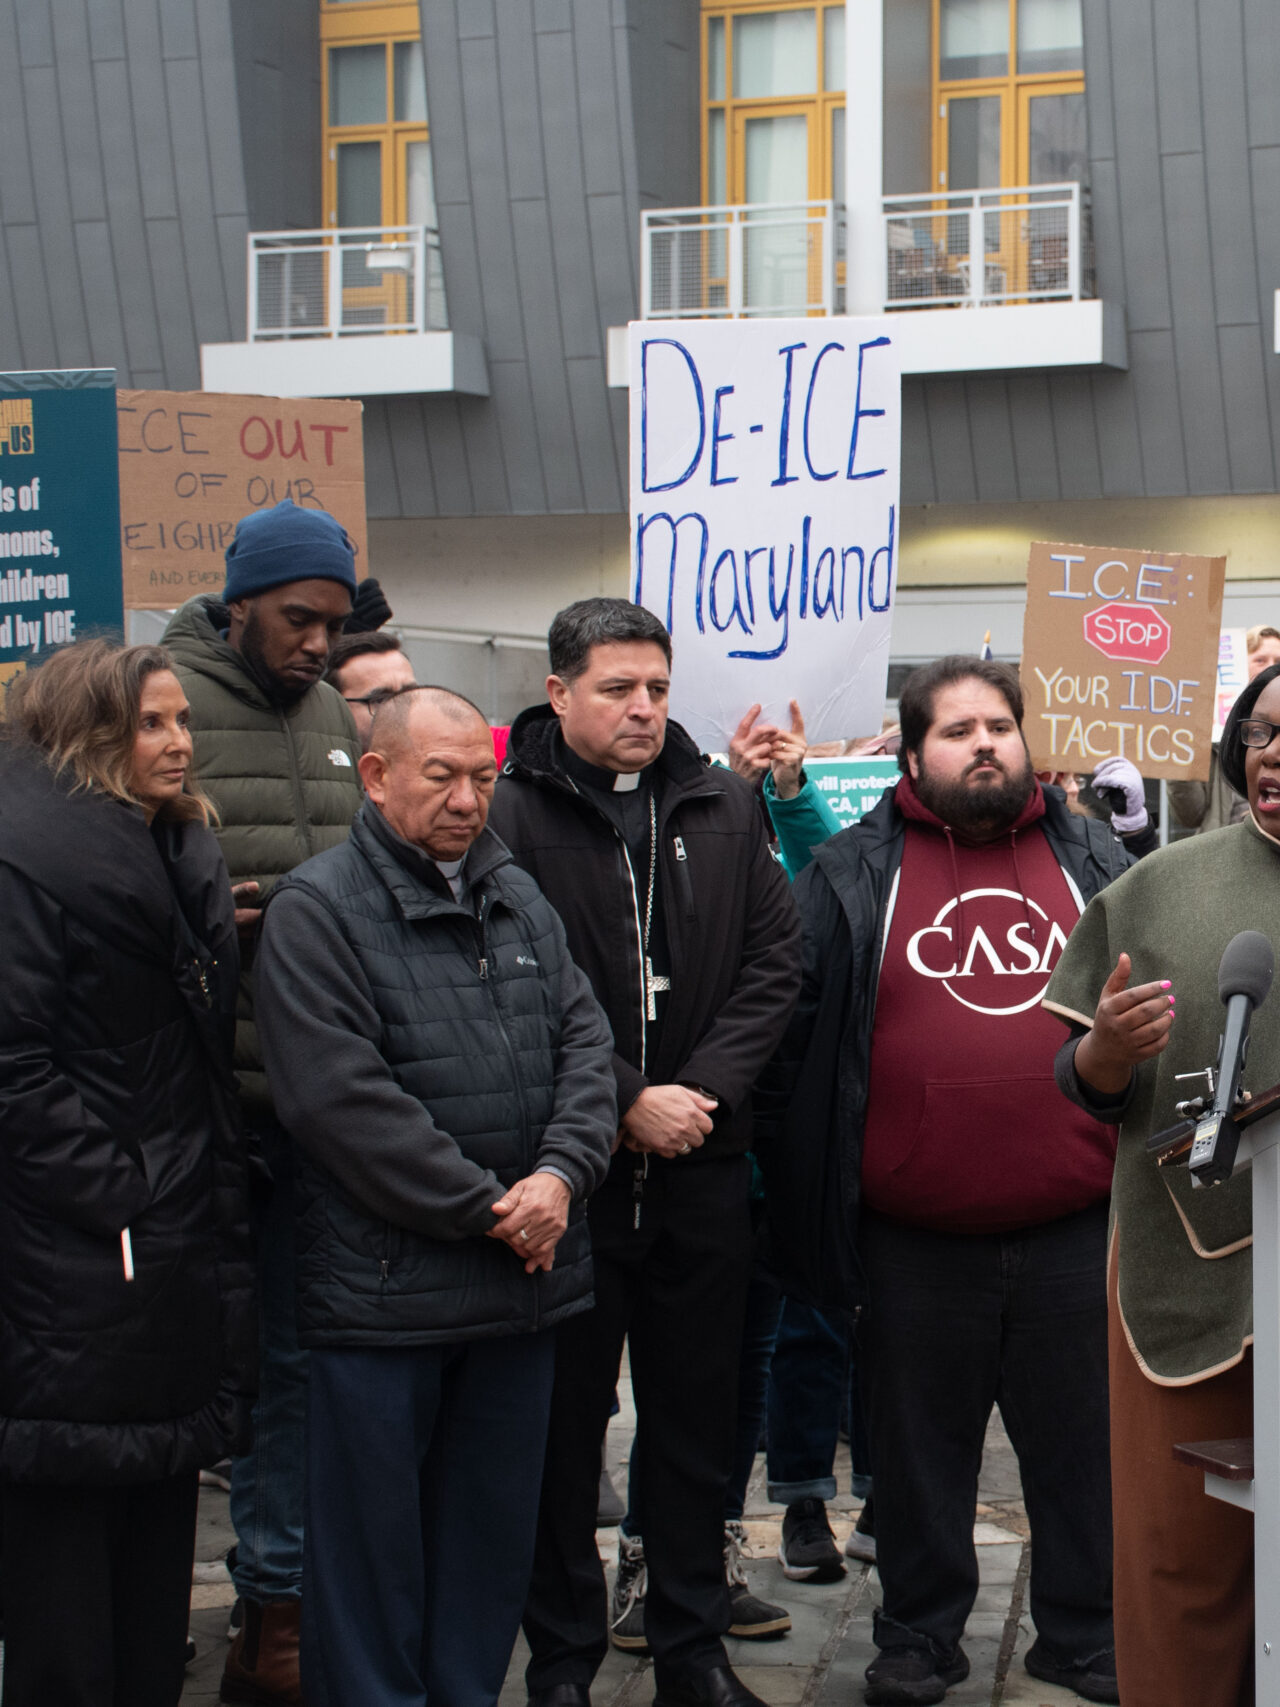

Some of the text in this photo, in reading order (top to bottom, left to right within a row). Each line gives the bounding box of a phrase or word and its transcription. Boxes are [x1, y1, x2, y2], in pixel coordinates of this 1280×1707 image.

[11, 425, 31, 453] US
[240, 416, 348, 466] OUT
[19, 477, 40, 511] of
[175, 472, 324, 509] OF OUR
[150, 569, 183, 586] AND
[635, 504, 895, 660] Maryland
[16, 613, 41, 653] by
[44, 610, 76, 644] ICE
[1094, 614, 1163, 647] STOP
[1034, 667, 1109, 709] YOUR
[1041, 714, 1195, 766] TACTICS
[840, 774, 901, 793] protect
[906, 921, 1068, 979] CASA
